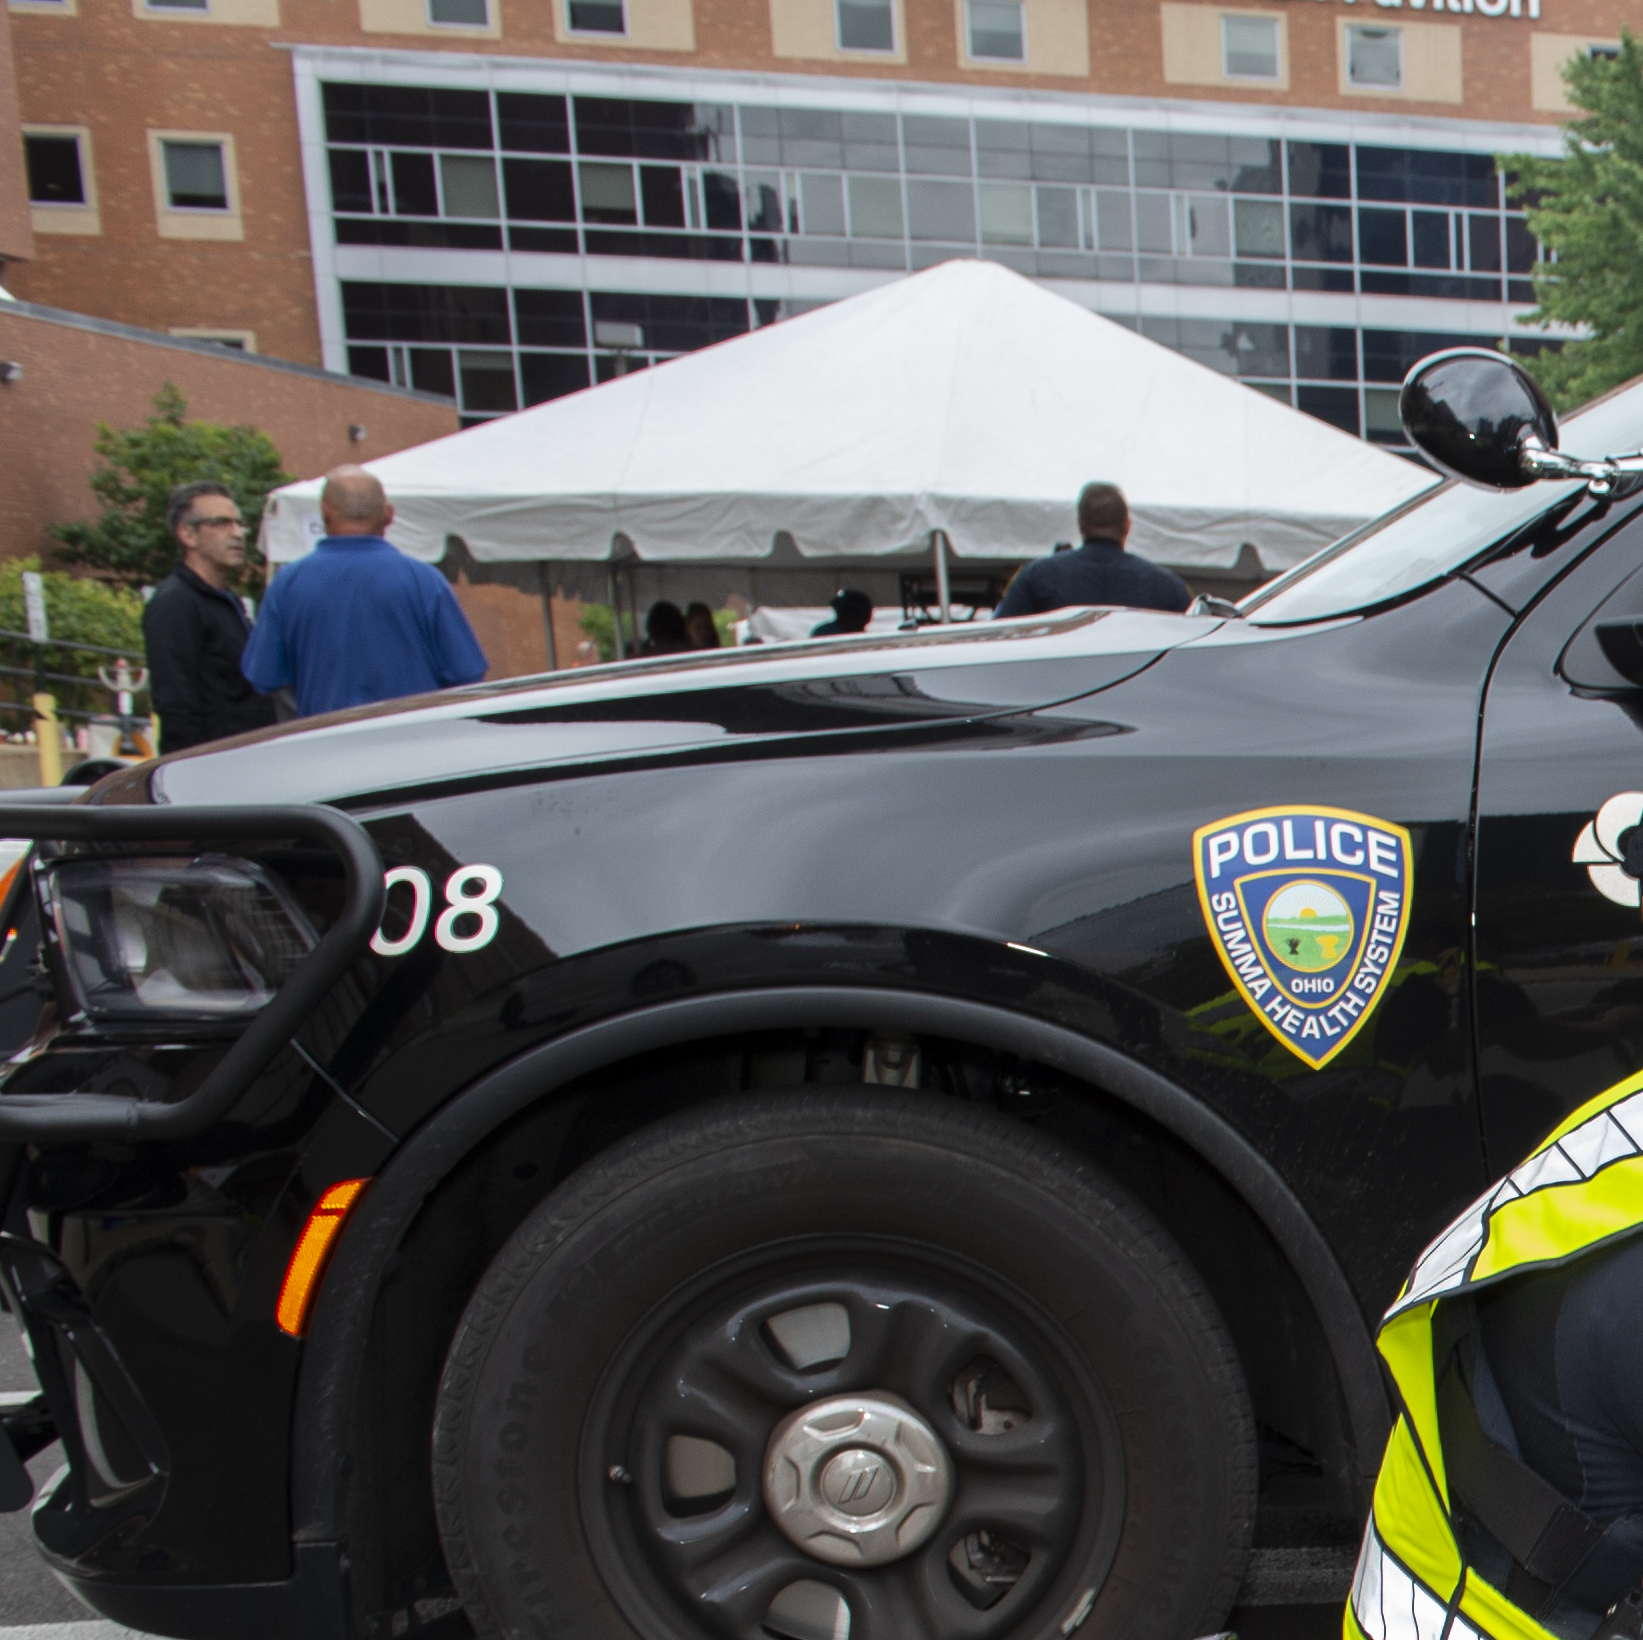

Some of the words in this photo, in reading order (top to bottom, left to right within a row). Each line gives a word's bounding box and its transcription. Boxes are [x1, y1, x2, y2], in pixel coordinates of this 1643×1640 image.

[1208, 819, 1400, 879] POLICE
[1212, 891, 1273, 1000] SUMMA
[1264, 991, 1366, 1039] HEALTH
[1353, 890, 1400, 995] SYSTEM
[1290, 977, 1335, 994] OHIO
